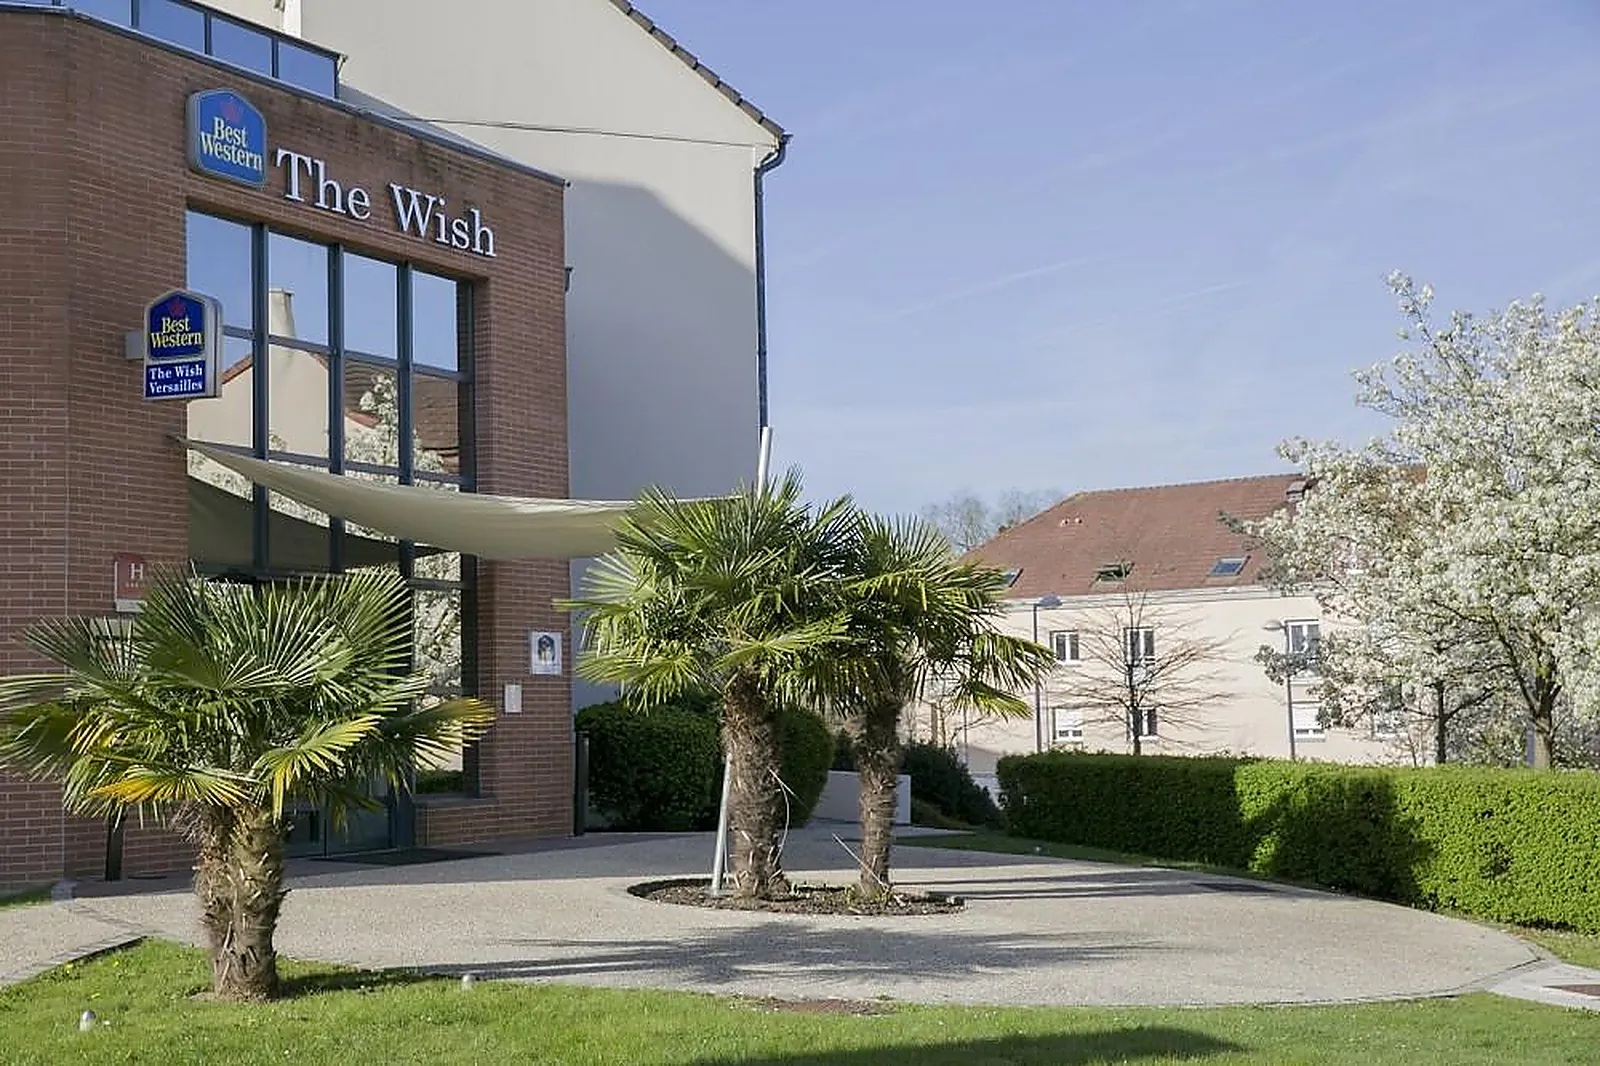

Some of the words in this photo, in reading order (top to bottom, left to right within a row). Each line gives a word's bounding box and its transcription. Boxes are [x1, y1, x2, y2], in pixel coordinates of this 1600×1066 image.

[213, 116, 247, 149] Best
[200, 131, 263, 172] Western
[275, 148, 371, 219] The
[389, 182, 497, 258] Wish
[162, 315, 191, 333] Best
[151, 332, 203, 348] Western
[149, 367, 172, 380] The
[175, 364, 203, 378] Wish
[149, 379, 203, 394] Versailles
[131, 563, 143, 580] H
